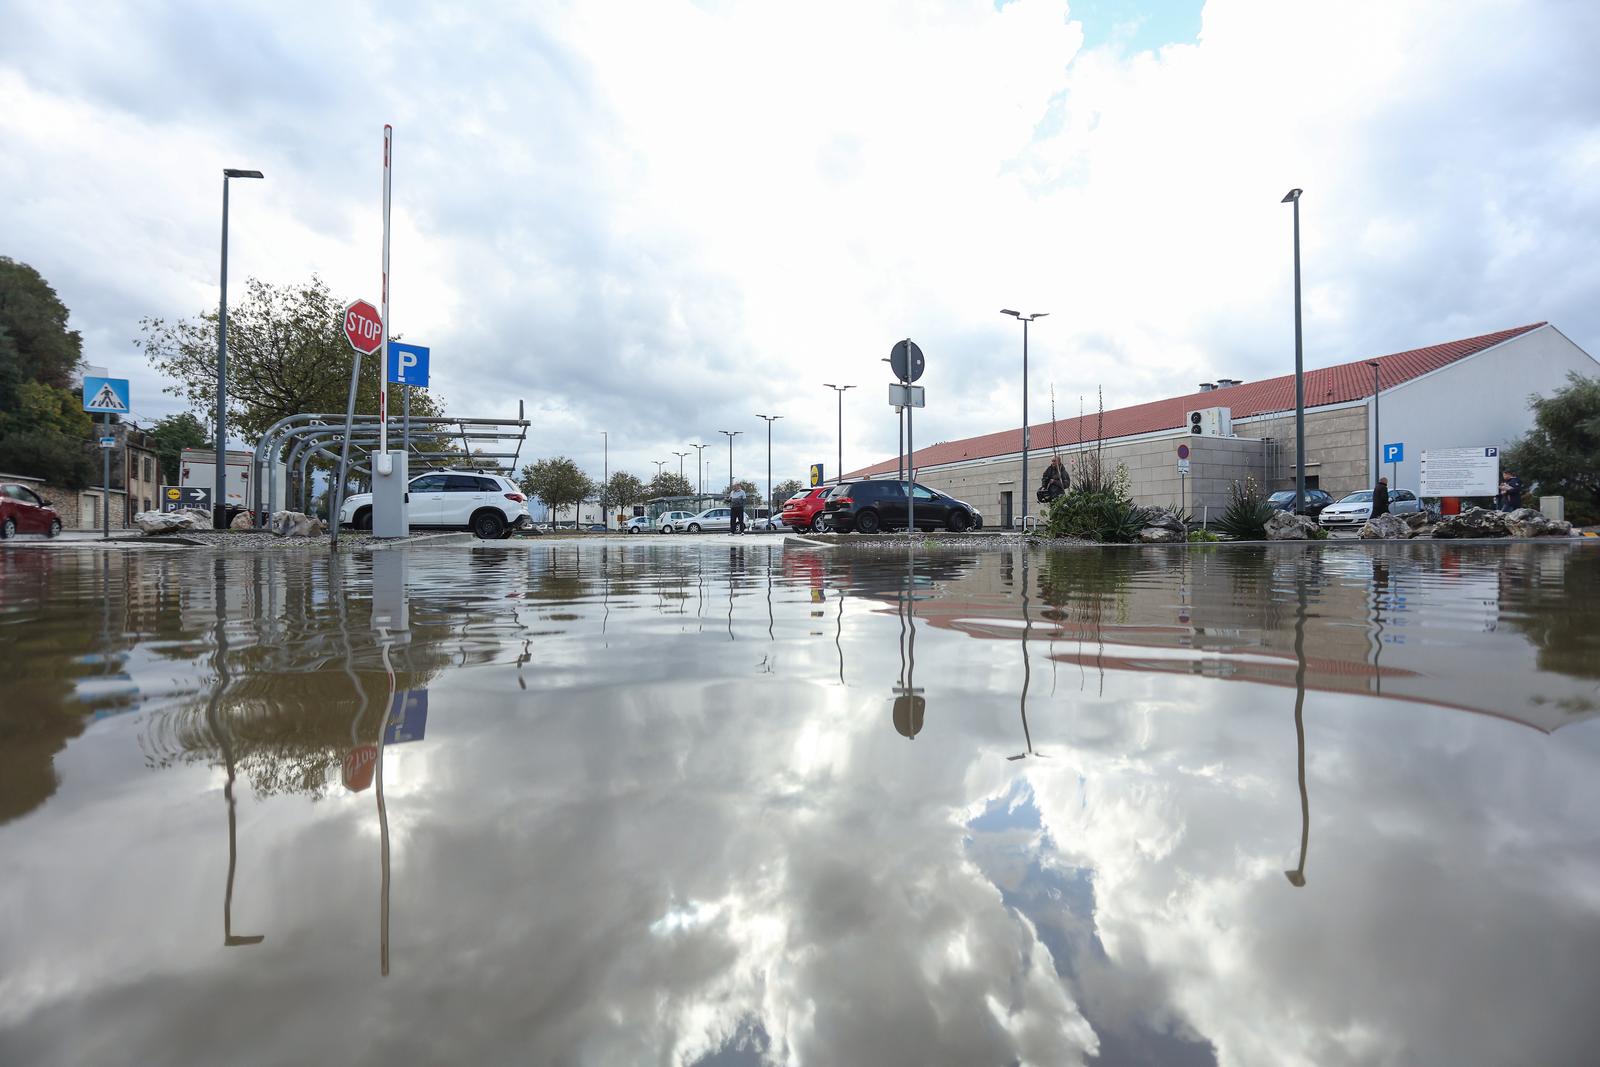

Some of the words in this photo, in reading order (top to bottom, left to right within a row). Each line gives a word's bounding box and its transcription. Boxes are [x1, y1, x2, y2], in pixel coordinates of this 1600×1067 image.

[347, 312, 381, 341] STOP
[398, 351, 417, 376] P
[1389, 447, 1398, 459] P
[1488, 449, 1495, 457] P
